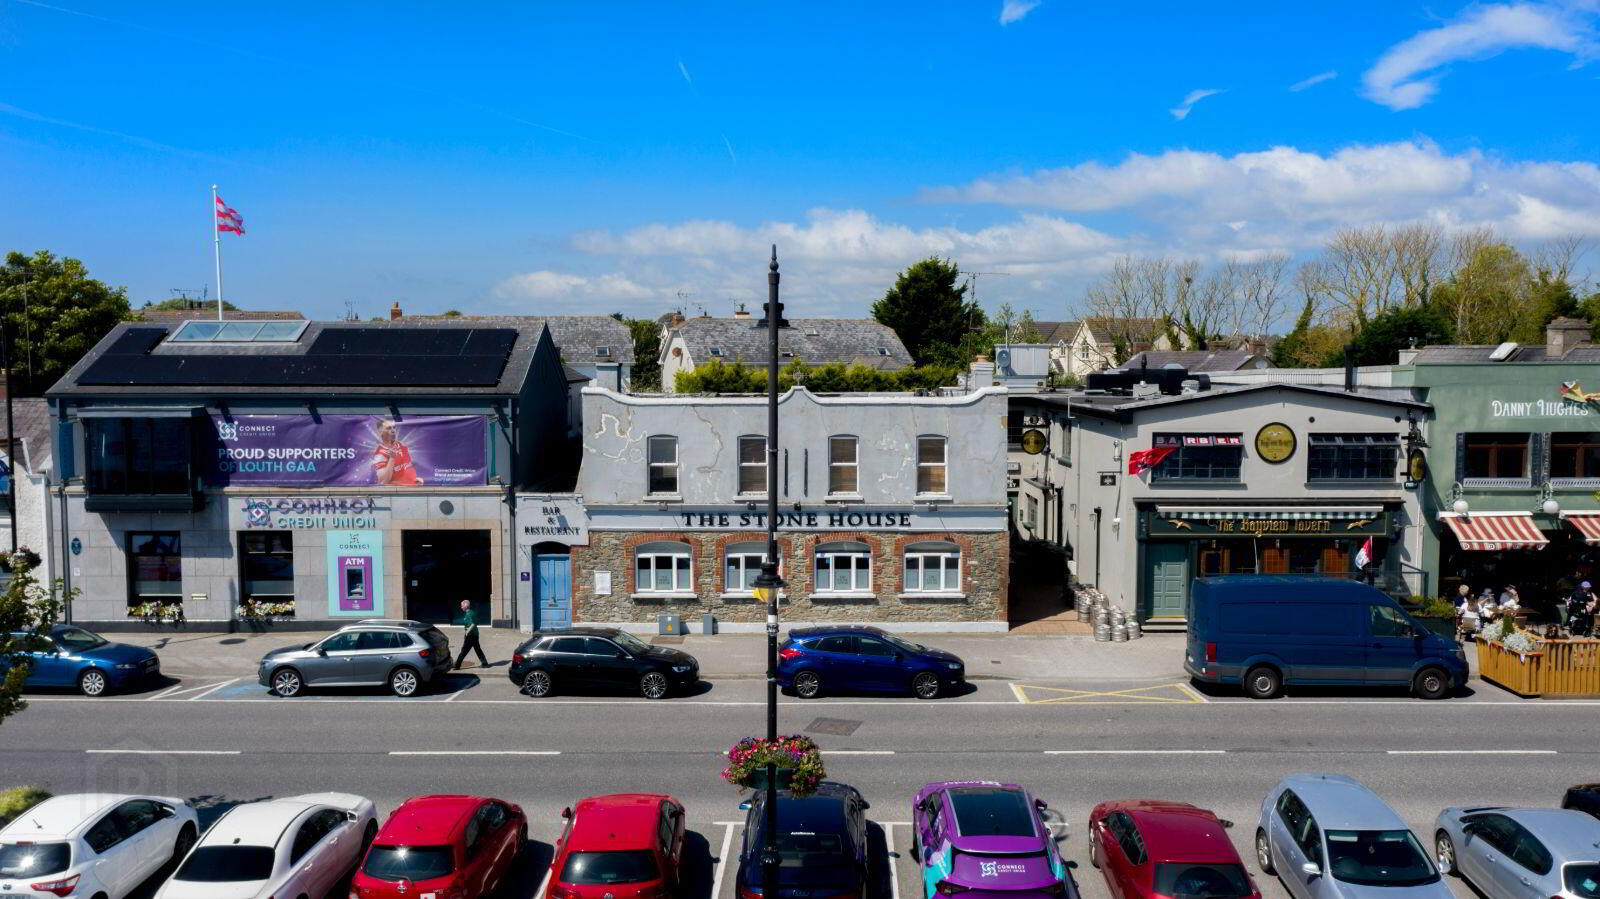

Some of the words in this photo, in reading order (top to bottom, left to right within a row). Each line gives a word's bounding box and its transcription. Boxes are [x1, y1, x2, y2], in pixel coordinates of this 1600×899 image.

[1492, 400, 1532, 416] DANNY
[1537, 399, 1588, 416] HUGHES
[1156, 436, 1240, 444] BARBER
[218, 448, 265, 459] PROUD
[268, 448, 356, 459] SUPPORTERS
[219, 461, 237, 472] OF
[239, 461, 283, 472] LOUTH
[286, 461, 316, 472] GAA
[277, 498, 376, 514] CONNECT
[542, 506, 561, 514] BAR
[278, 517, 326, 529] CREDIT
[332, 517, 376, 529] UNION
[547, 517, 556, 525] &
[681, 512, 730, 527] THE
[829, 512, 912, 527] HOUSE
[524, 526, 581, 535] RESTAURANT
[1211, 519, 1234, 532] The
[1241, 519, 1289, 532] Bayview
[1295, 519, 1331, 531] Tavern
